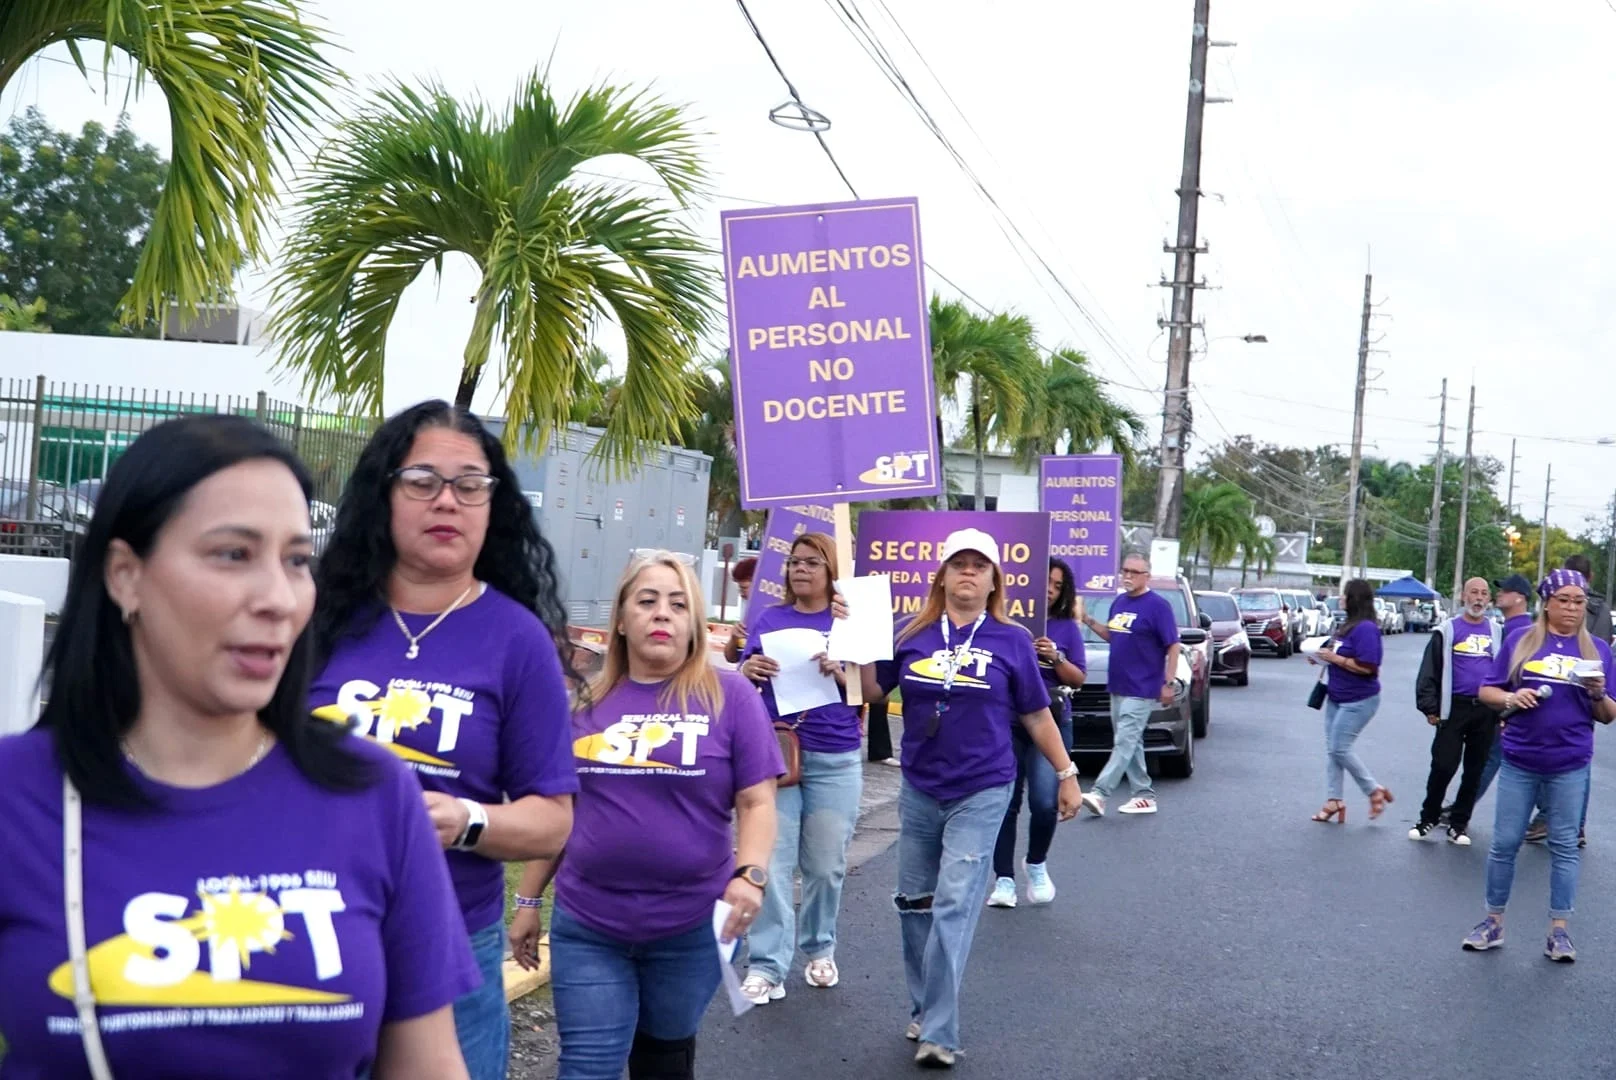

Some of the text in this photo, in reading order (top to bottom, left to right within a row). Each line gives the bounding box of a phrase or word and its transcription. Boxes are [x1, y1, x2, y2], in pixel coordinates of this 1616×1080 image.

[737, 243, 911, 279] AUMENTOS
[808, 286, 846, 309] AL
[748, 317, 911, 350] PERSONAL
[809, 358, 855, 383] NO
[763, 390, 906, 423] DOCENTE
[875, 453, 929, 479] SPT
[1046, 477, 1116, 488] AUMENTOS
[1072, 494, 1088, 505] AL
[1050, 510, 1112, 522] PERSONAL
[1069, 528, 1088, 539] NO
[1051, 545, 1108, 556] DOCENTE
[597, 722, 710, 766] SPT
[122, 888, 346, 987] SPT
